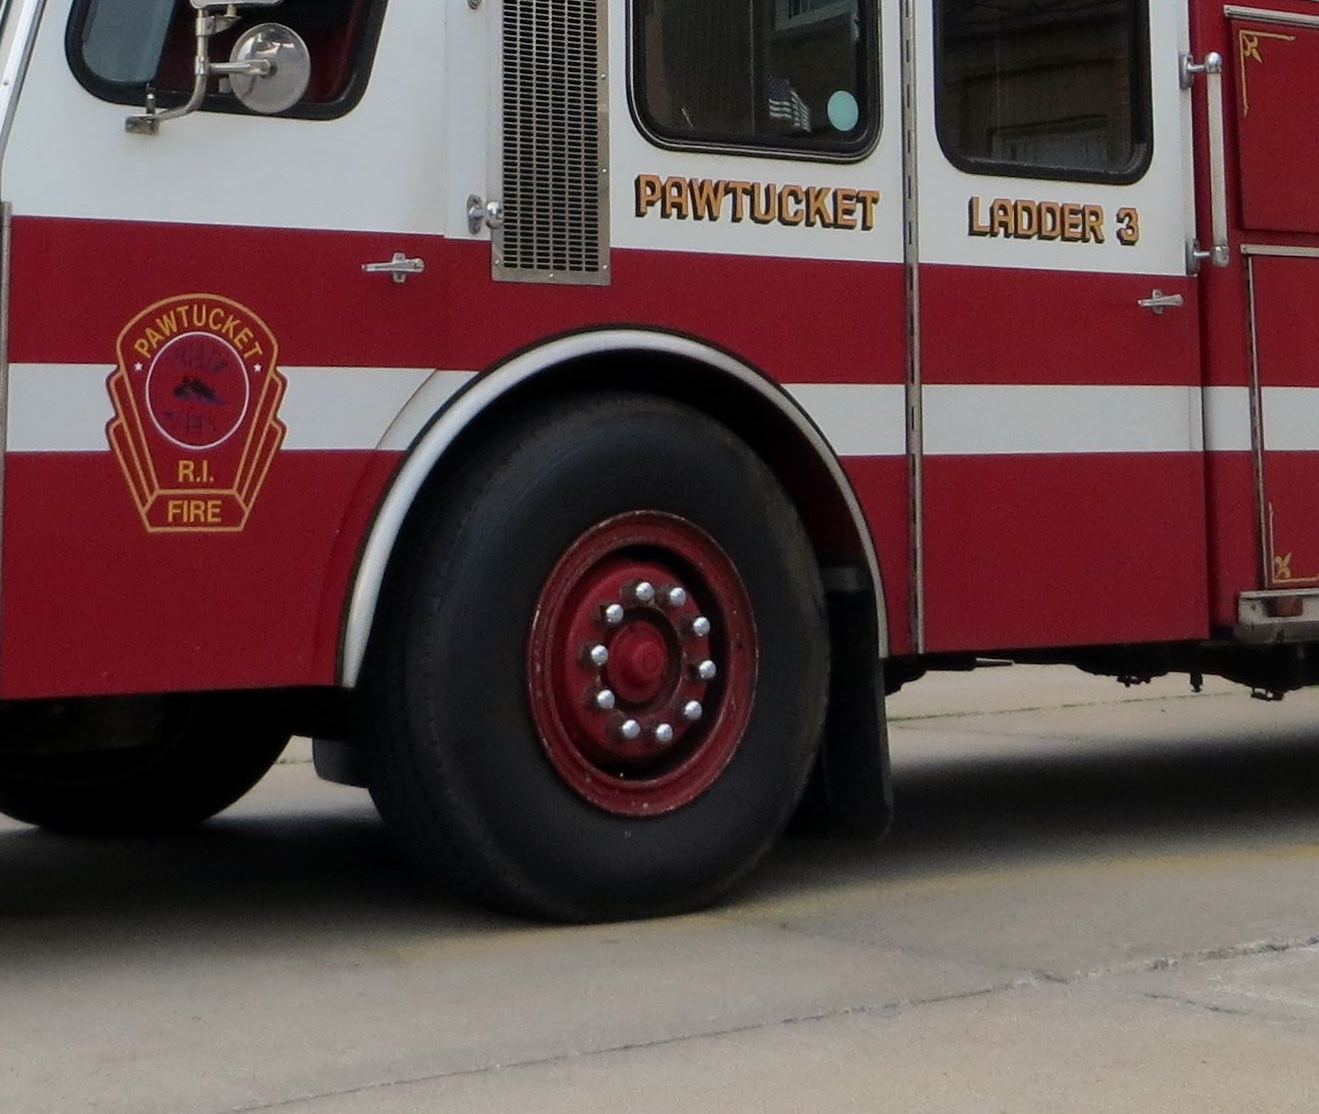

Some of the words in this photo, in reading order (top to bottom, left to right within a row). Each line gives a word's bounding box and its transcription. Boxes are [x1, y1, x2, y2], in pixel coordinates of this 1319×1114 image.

[633, 174, 880, 230] PAWTUCKET
[968, 196, 1105, 243] LADDER
[1116, 206, 1140, 245] 3
[134, 304, 263, 359] PAWTUCKET
[178, 460, 214, 483] R.I.
[168, 500, 222, 523] FIRE
